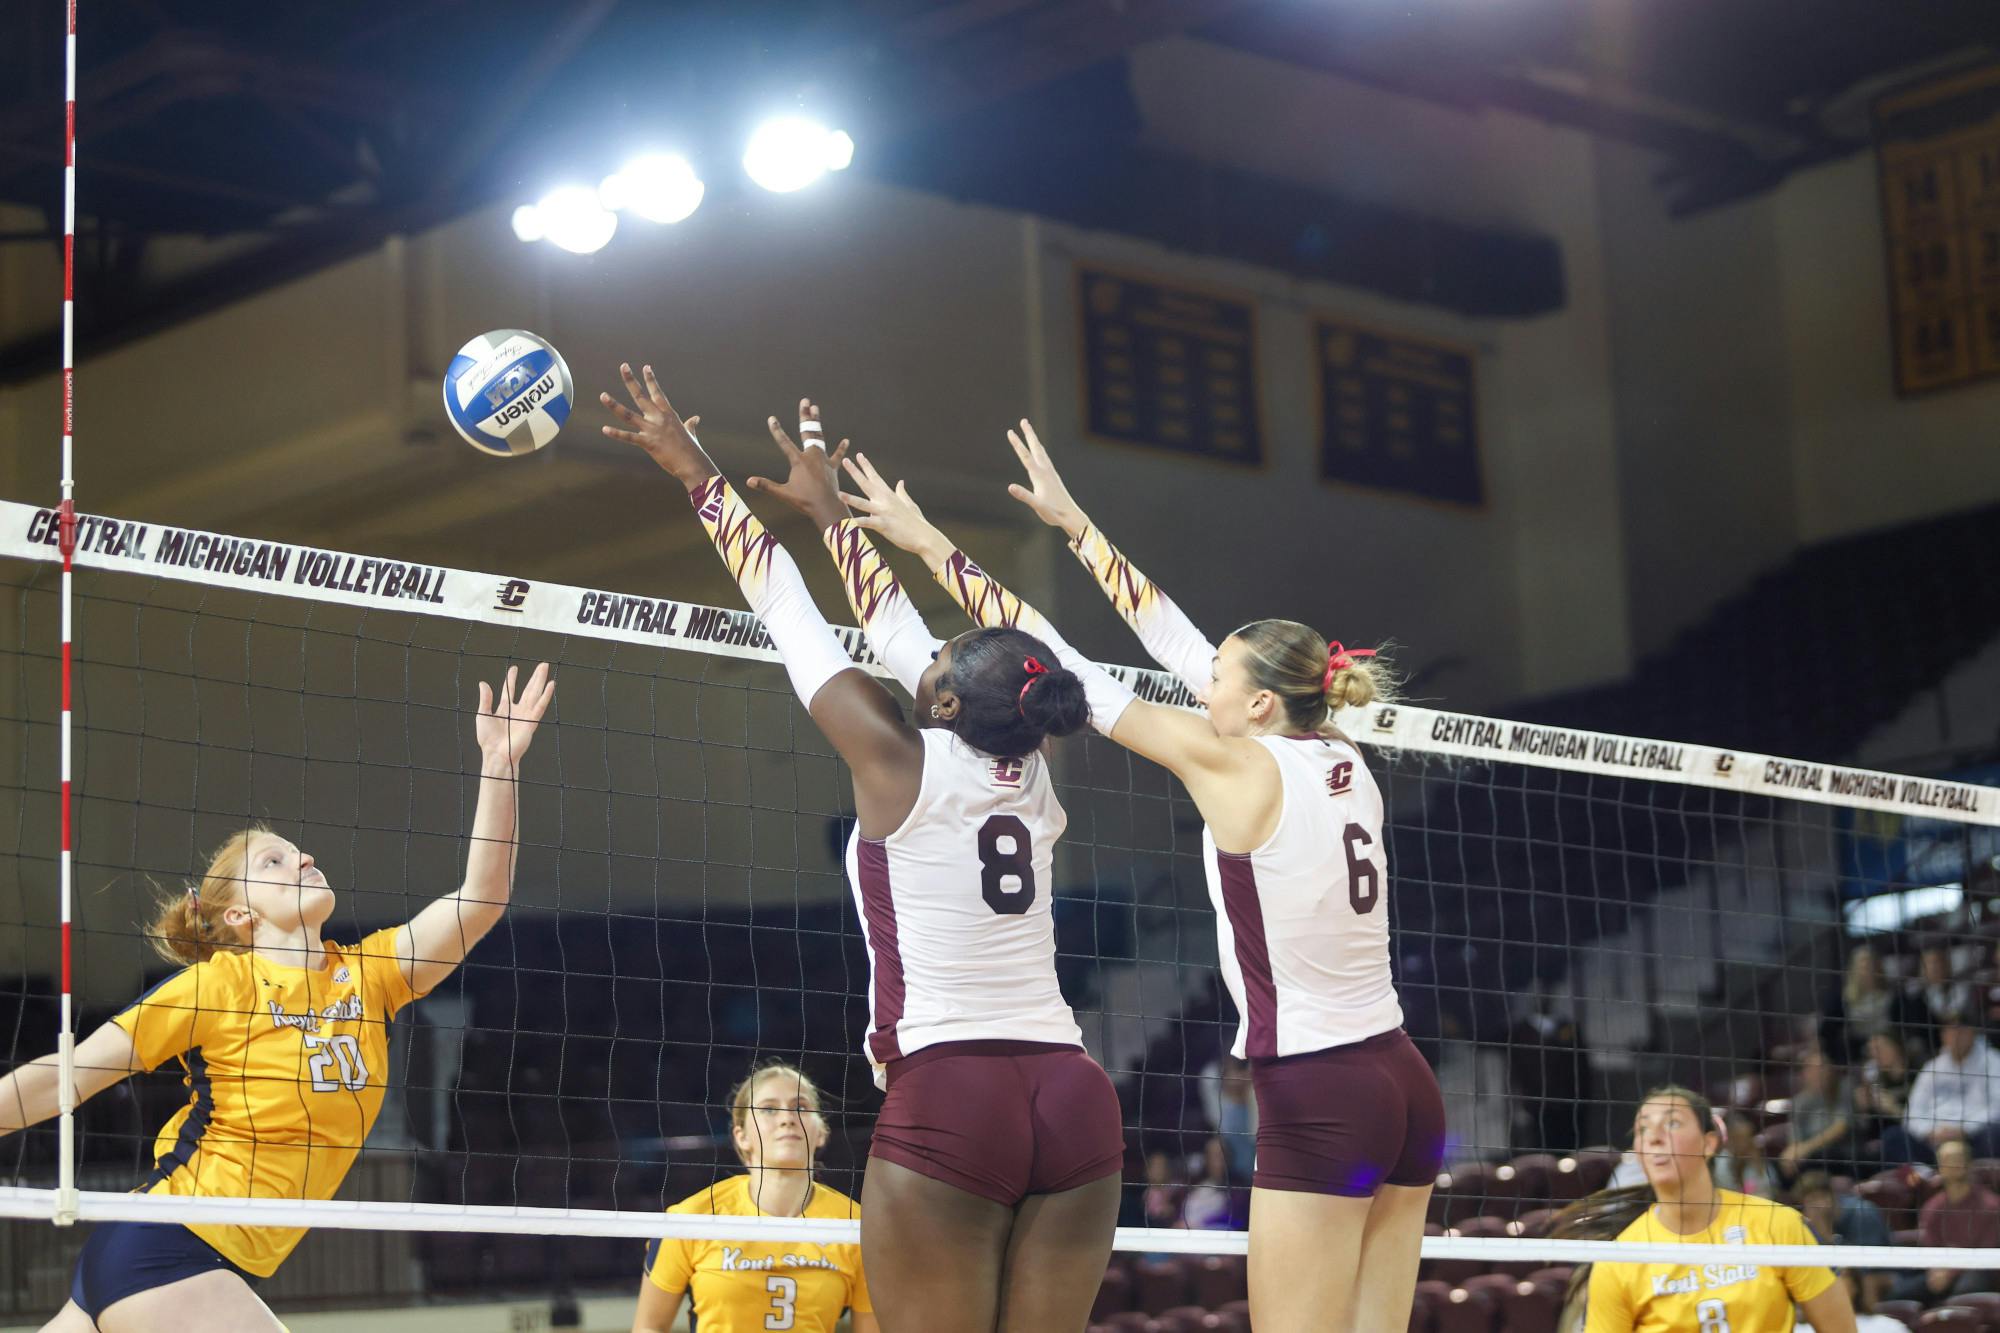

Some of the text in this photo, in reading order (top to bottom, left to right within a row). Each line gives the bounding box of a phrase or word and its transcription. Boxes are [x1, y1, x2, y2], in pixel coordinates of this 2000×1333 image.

[494, 374, 556, 428] molten
[154, 529, 292, 581] MICHIGAN
[293, 550, 447, 603] VOLLEYBALL
[577, 591, 678, 636] CENTRAL
[1431, 716, 1683, 772] CENTRAL MICHIGAN VOLLEYBALL
[1763, 759, 1979, 813] CENTRAL MICHIGAN VOLLEYBALL
[978, 815, 1035, 915] 8
[1343, 822, 1378, 915] 6
[303, 1034, 369, 1092] 20
[722, 1247, 775, 1271] Kent
[1651, 1269, 1700, 1296] Kent
[764, 1275, 798, 1330] 3
